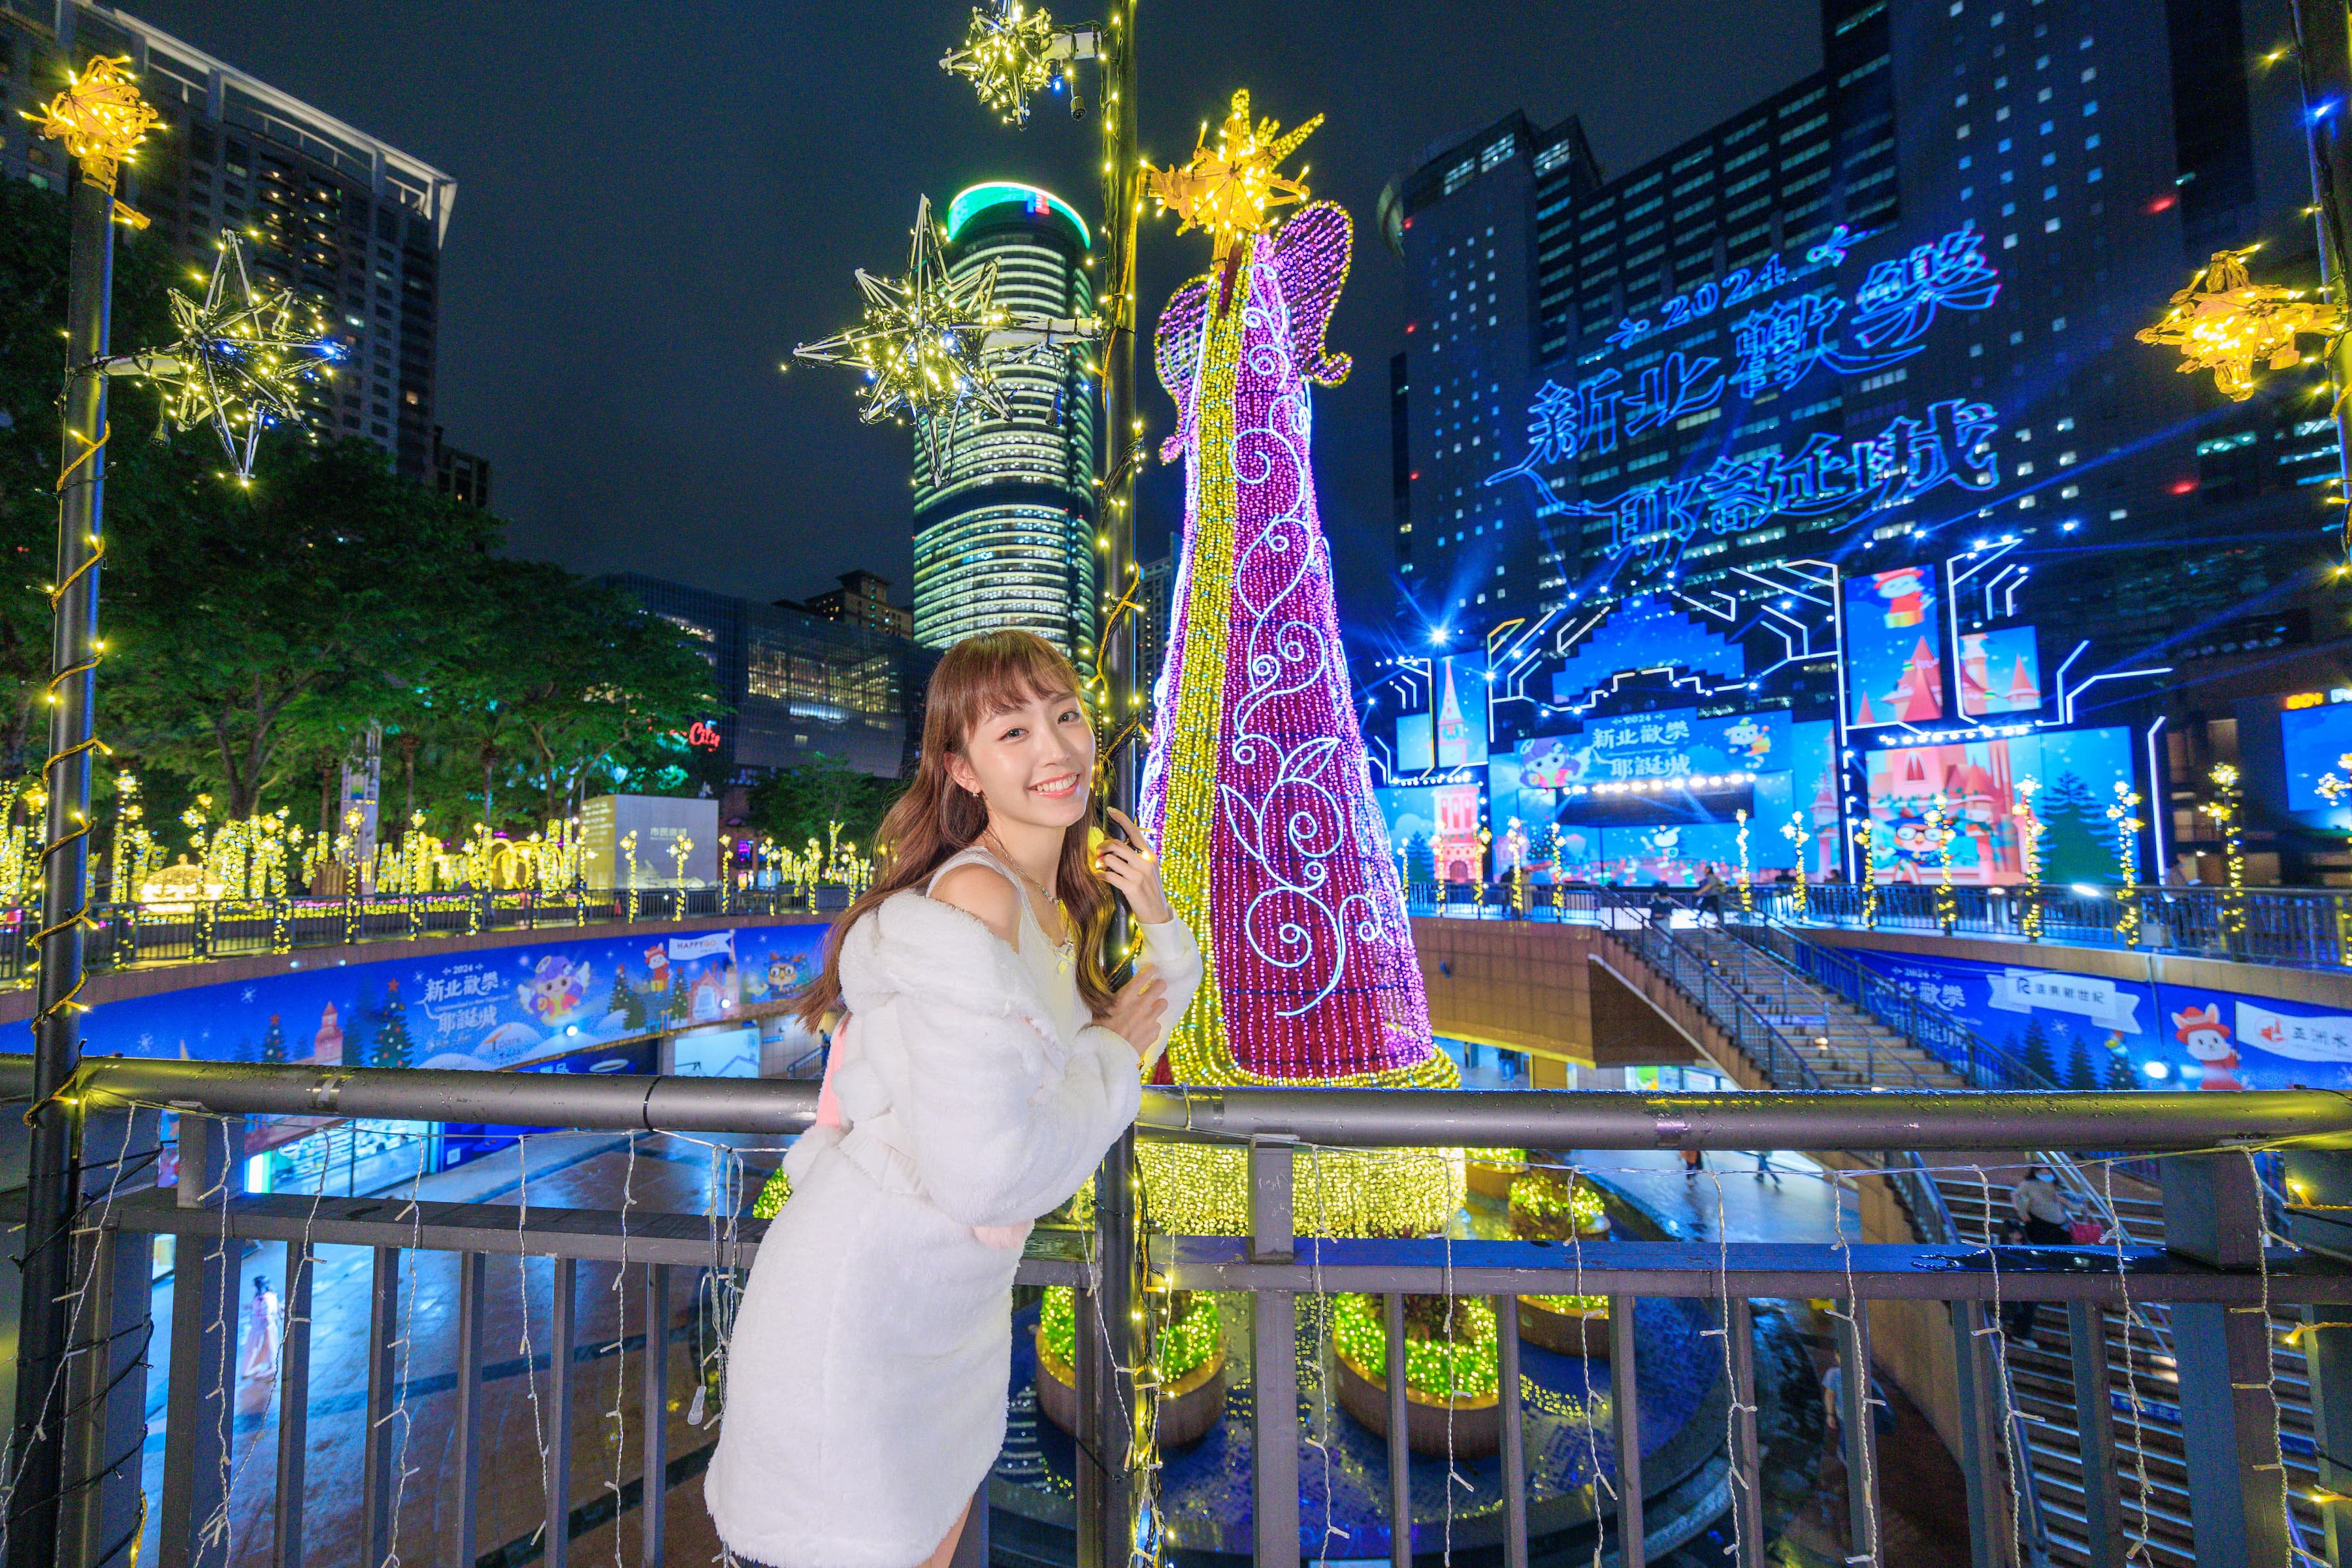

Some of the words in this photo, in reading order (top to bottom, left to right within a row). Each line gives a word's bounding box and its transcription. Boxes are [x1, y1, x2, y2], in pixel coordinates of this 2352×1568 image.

[1661, 253, 1788, 331] 2024
[1592, 397, 2001, 576] 耶誕城
[689, 722, 721, 752] City
[1592, 720, 1690, 749] 新北歡樂
[1610, 753, 1691, 781] 耶誕城
[453, 964, 474, 974] 2024
[424, 971, 499, 1002] 新北歡樂
[437, 1004, 497, 1037] 耶誕城
